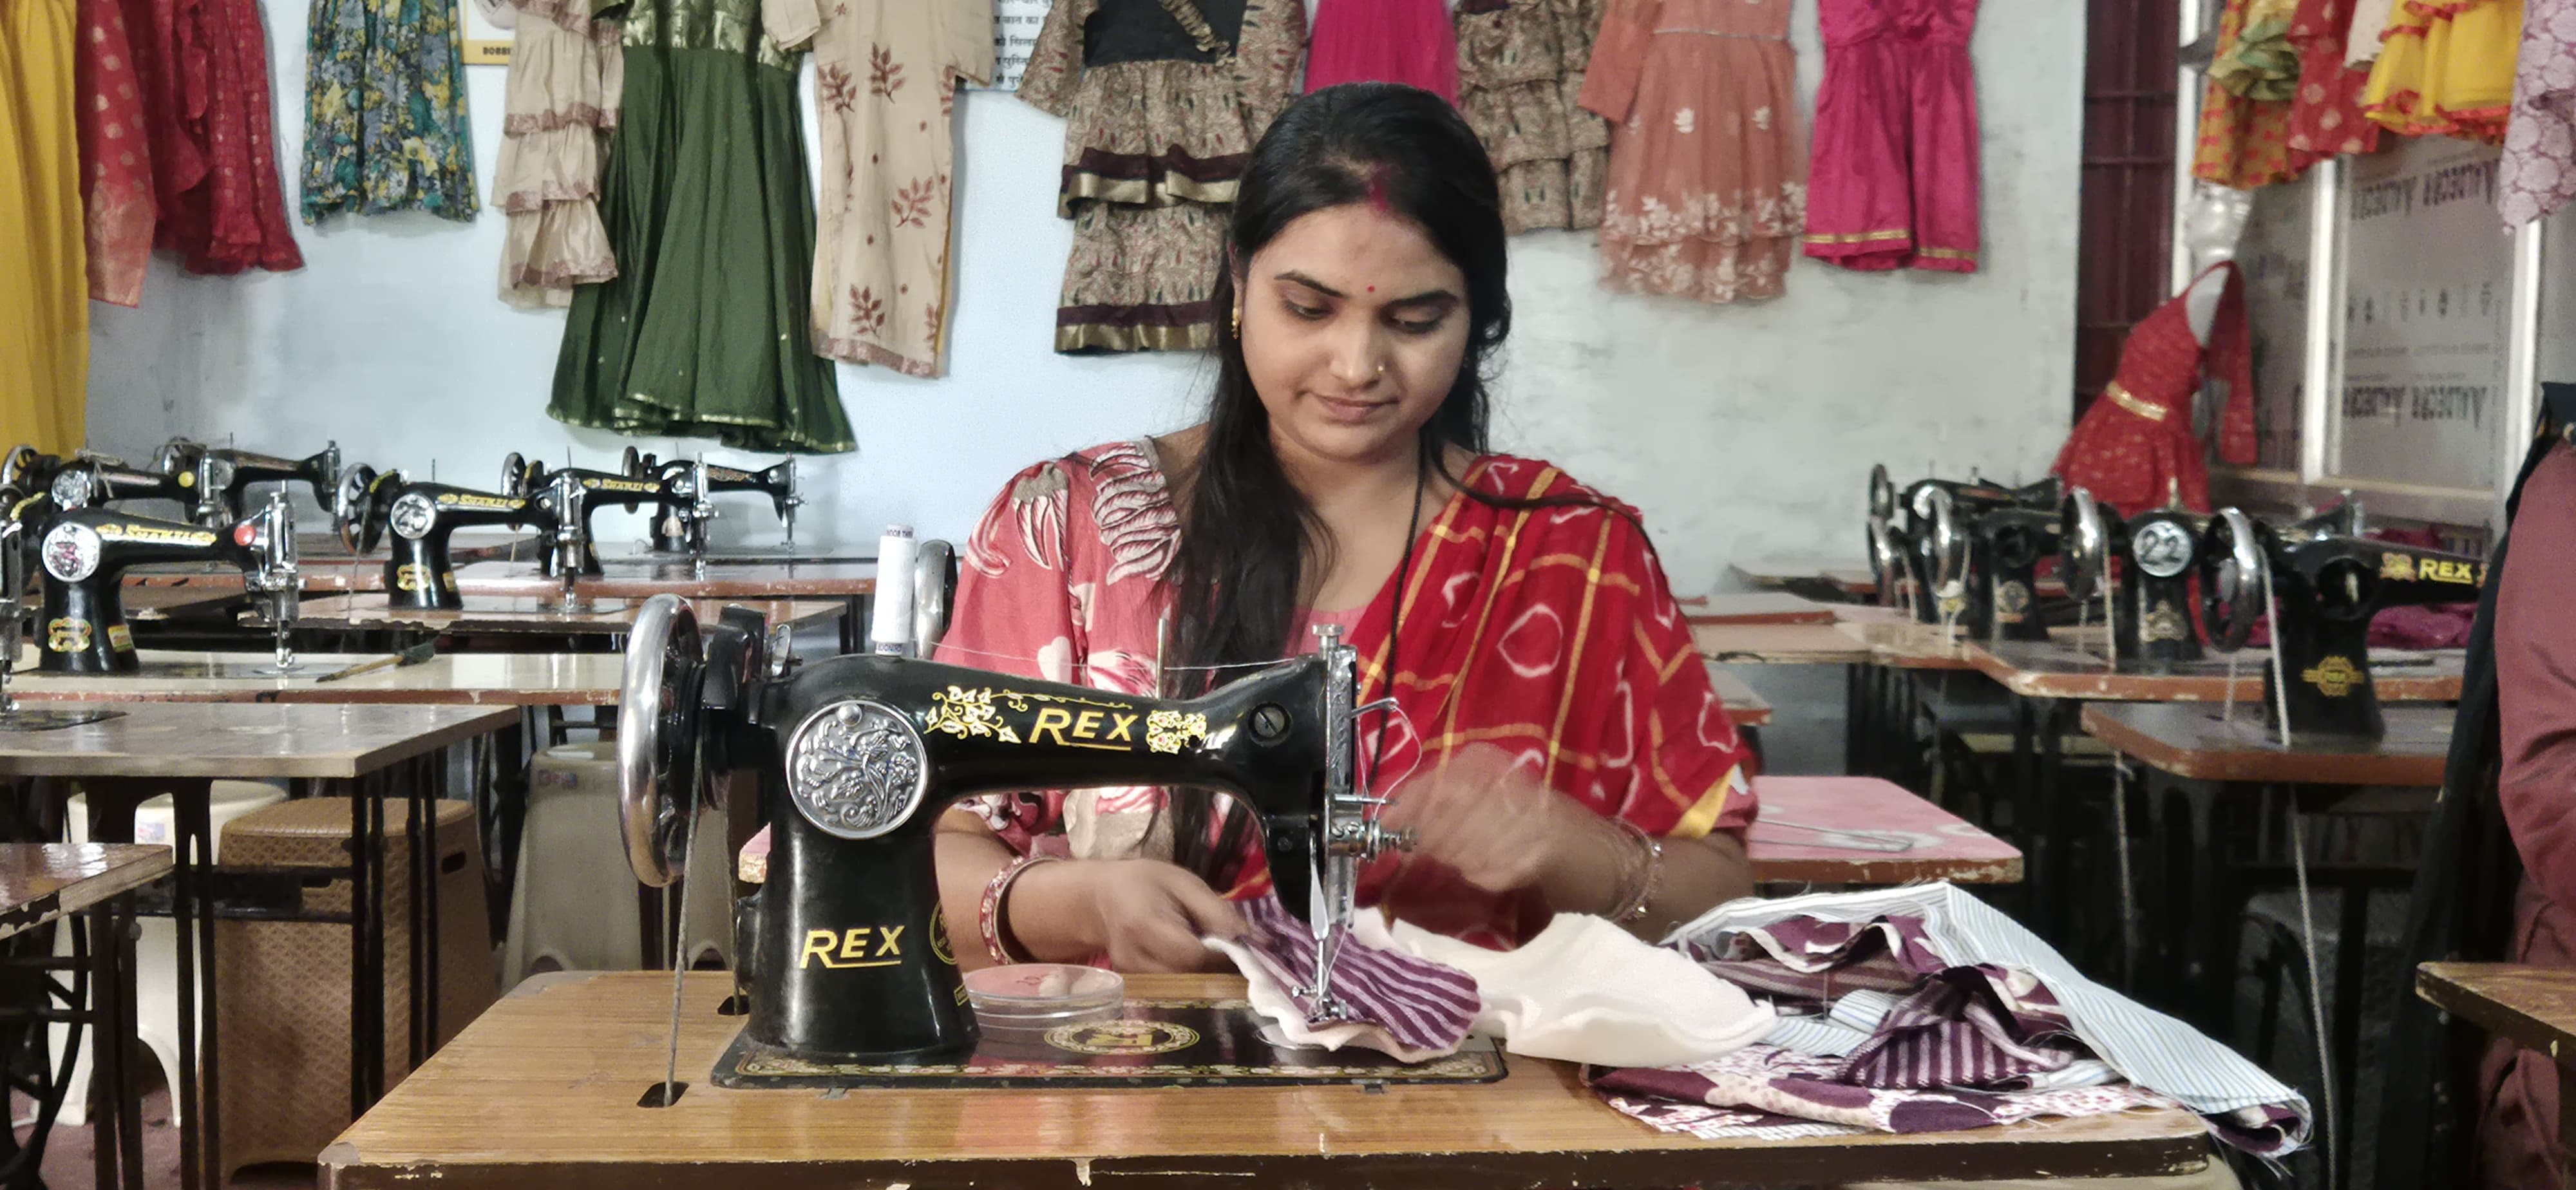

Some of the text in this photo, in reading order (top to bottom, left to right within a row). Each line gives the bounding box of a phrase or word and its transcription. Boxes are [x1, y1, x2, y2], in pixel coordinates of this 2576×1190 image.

[483, 46, 511, 55] BOBBI
[2141, 529, 2183, 565] 22
[2418, 558, 2474, 585] REX
[1028, 707, 1139, 751] REX
[799, 925, 905, 969] REX
